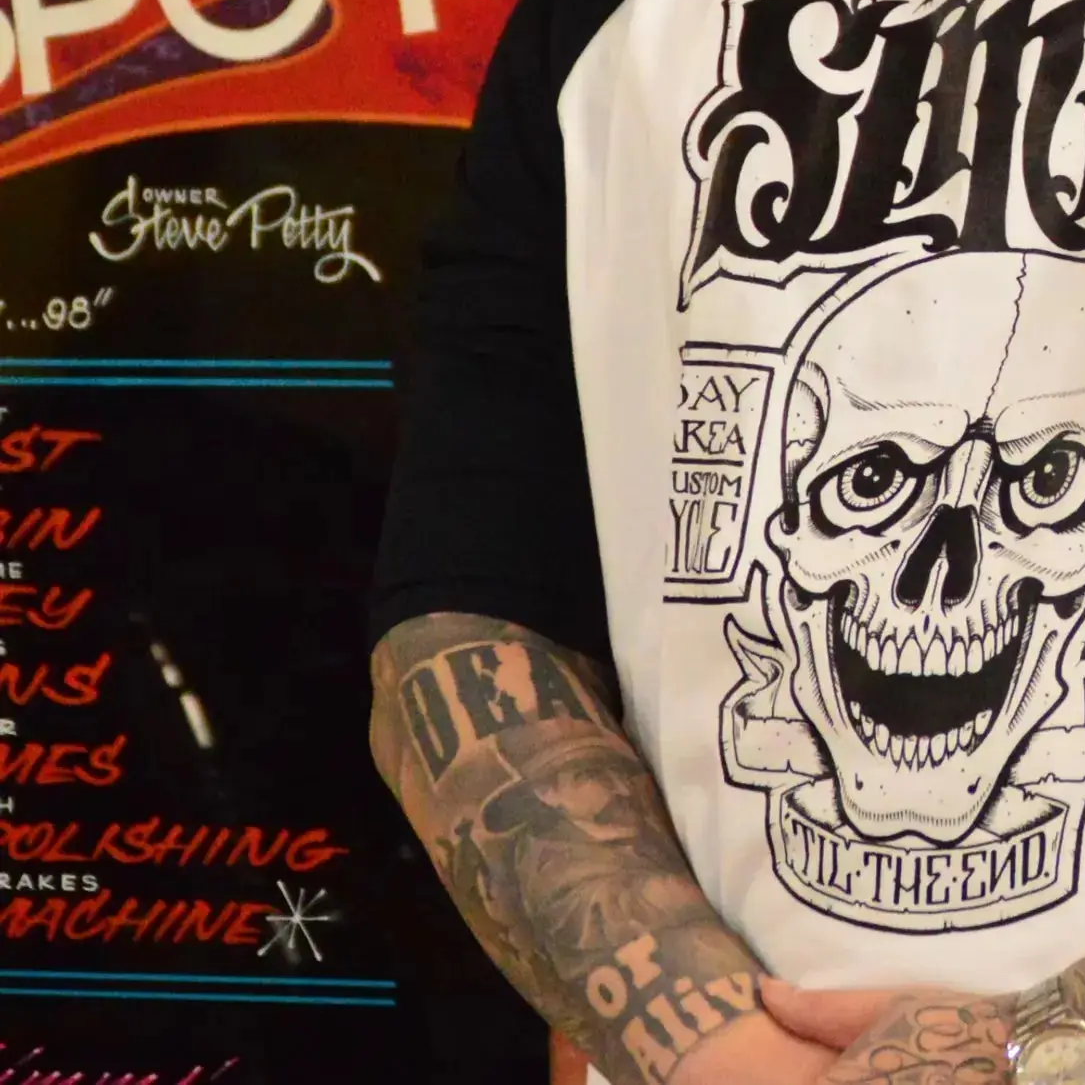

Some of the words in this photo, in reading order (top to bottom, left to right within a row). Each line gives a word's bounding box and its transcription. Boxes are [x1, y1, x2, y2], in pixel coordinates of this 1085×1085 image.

[89, 173, 229, 261] Steve
[142, 187, 228, 210] OWNER
[673, 419, 747, 456] REA
[863, 851, 952, 905] THE
[0, 888, 281, 945] MACHINE
